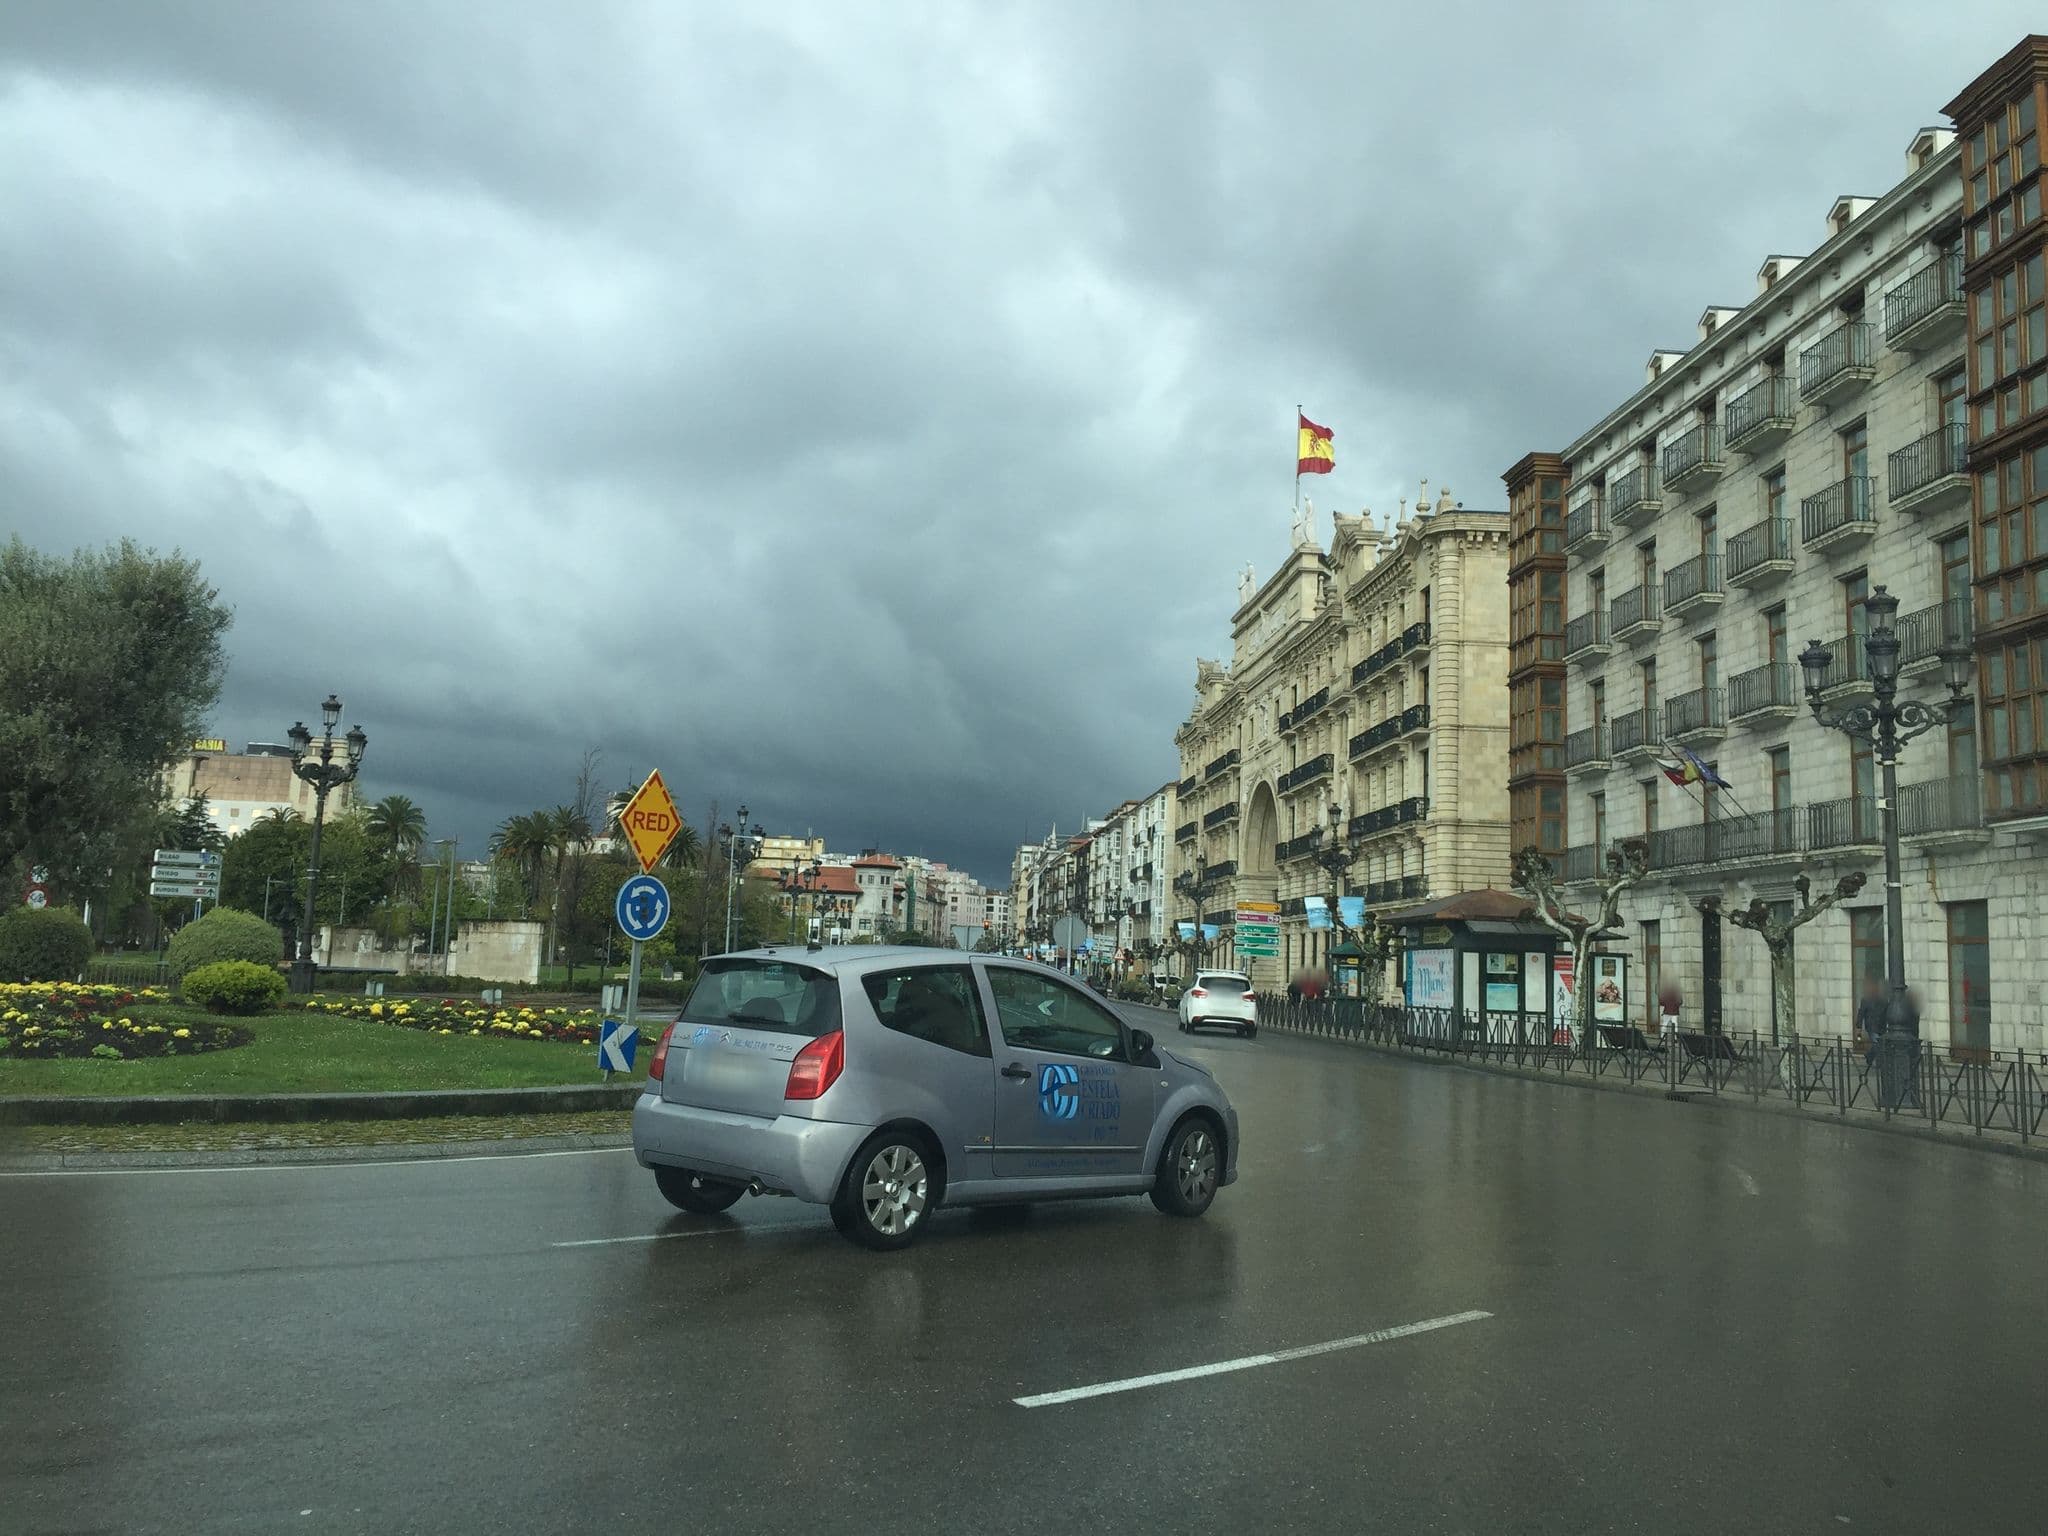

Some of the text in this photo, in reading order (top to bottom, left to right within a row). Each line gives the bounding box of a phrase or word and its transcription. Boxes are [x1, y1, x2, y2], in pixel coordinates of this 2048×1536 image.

[632, 811, 670, 832] RED
[156, 869, 179, 877] OVIEDO
[1081, 1079, 1120, 1099] ESTELA
